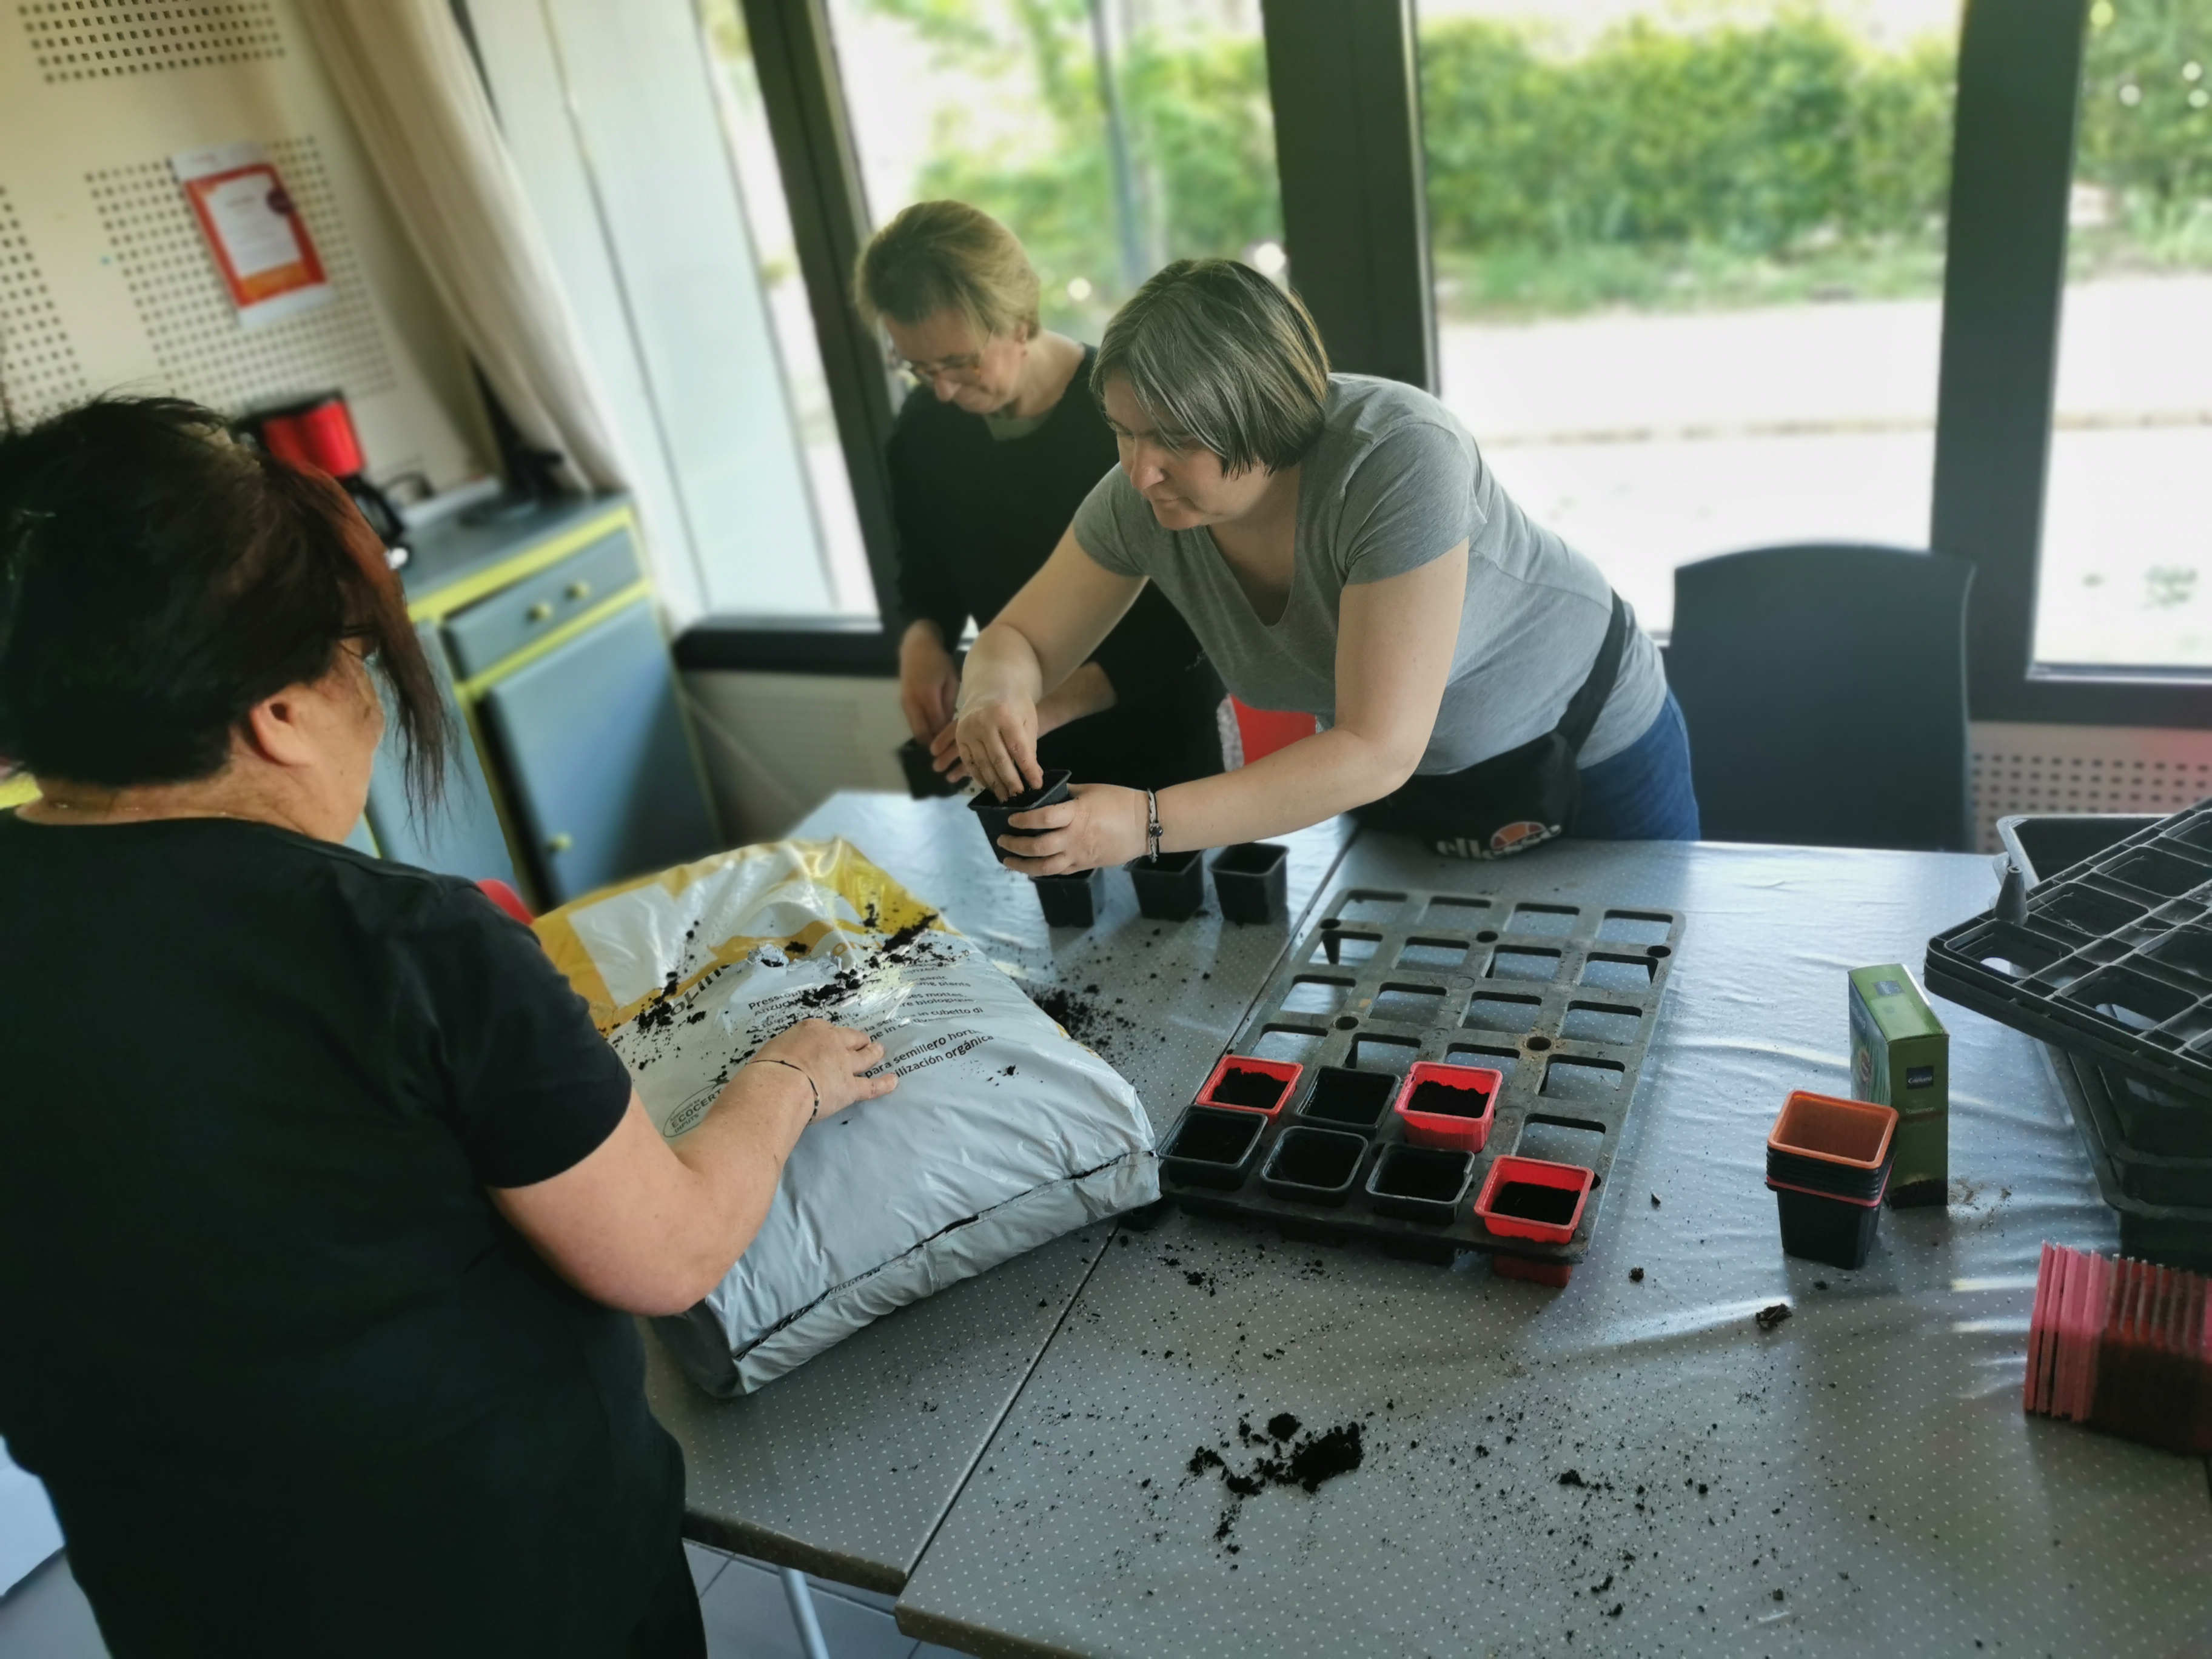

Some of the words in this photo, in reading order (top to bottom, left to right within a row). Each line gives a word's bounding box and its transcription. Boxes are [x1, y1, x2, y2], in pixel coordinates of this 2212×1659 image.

[930, 1008, 971, 1016] cubetto
[973, 1005, 985, 1014] di
[885, 1025, 897, 1034] in
[865, 1061, 893, 1079] para
[893, 1036, 947, 1064] semillero
[947, 1029, 983, 1041] horti
[891, 1055, 944, 1078] ilización
[945, 1034, 994, 1056] orgánica
[671, 1087, 723, 1128] ECOCERT
[674, 1113, 700, 1133] INPUTS
